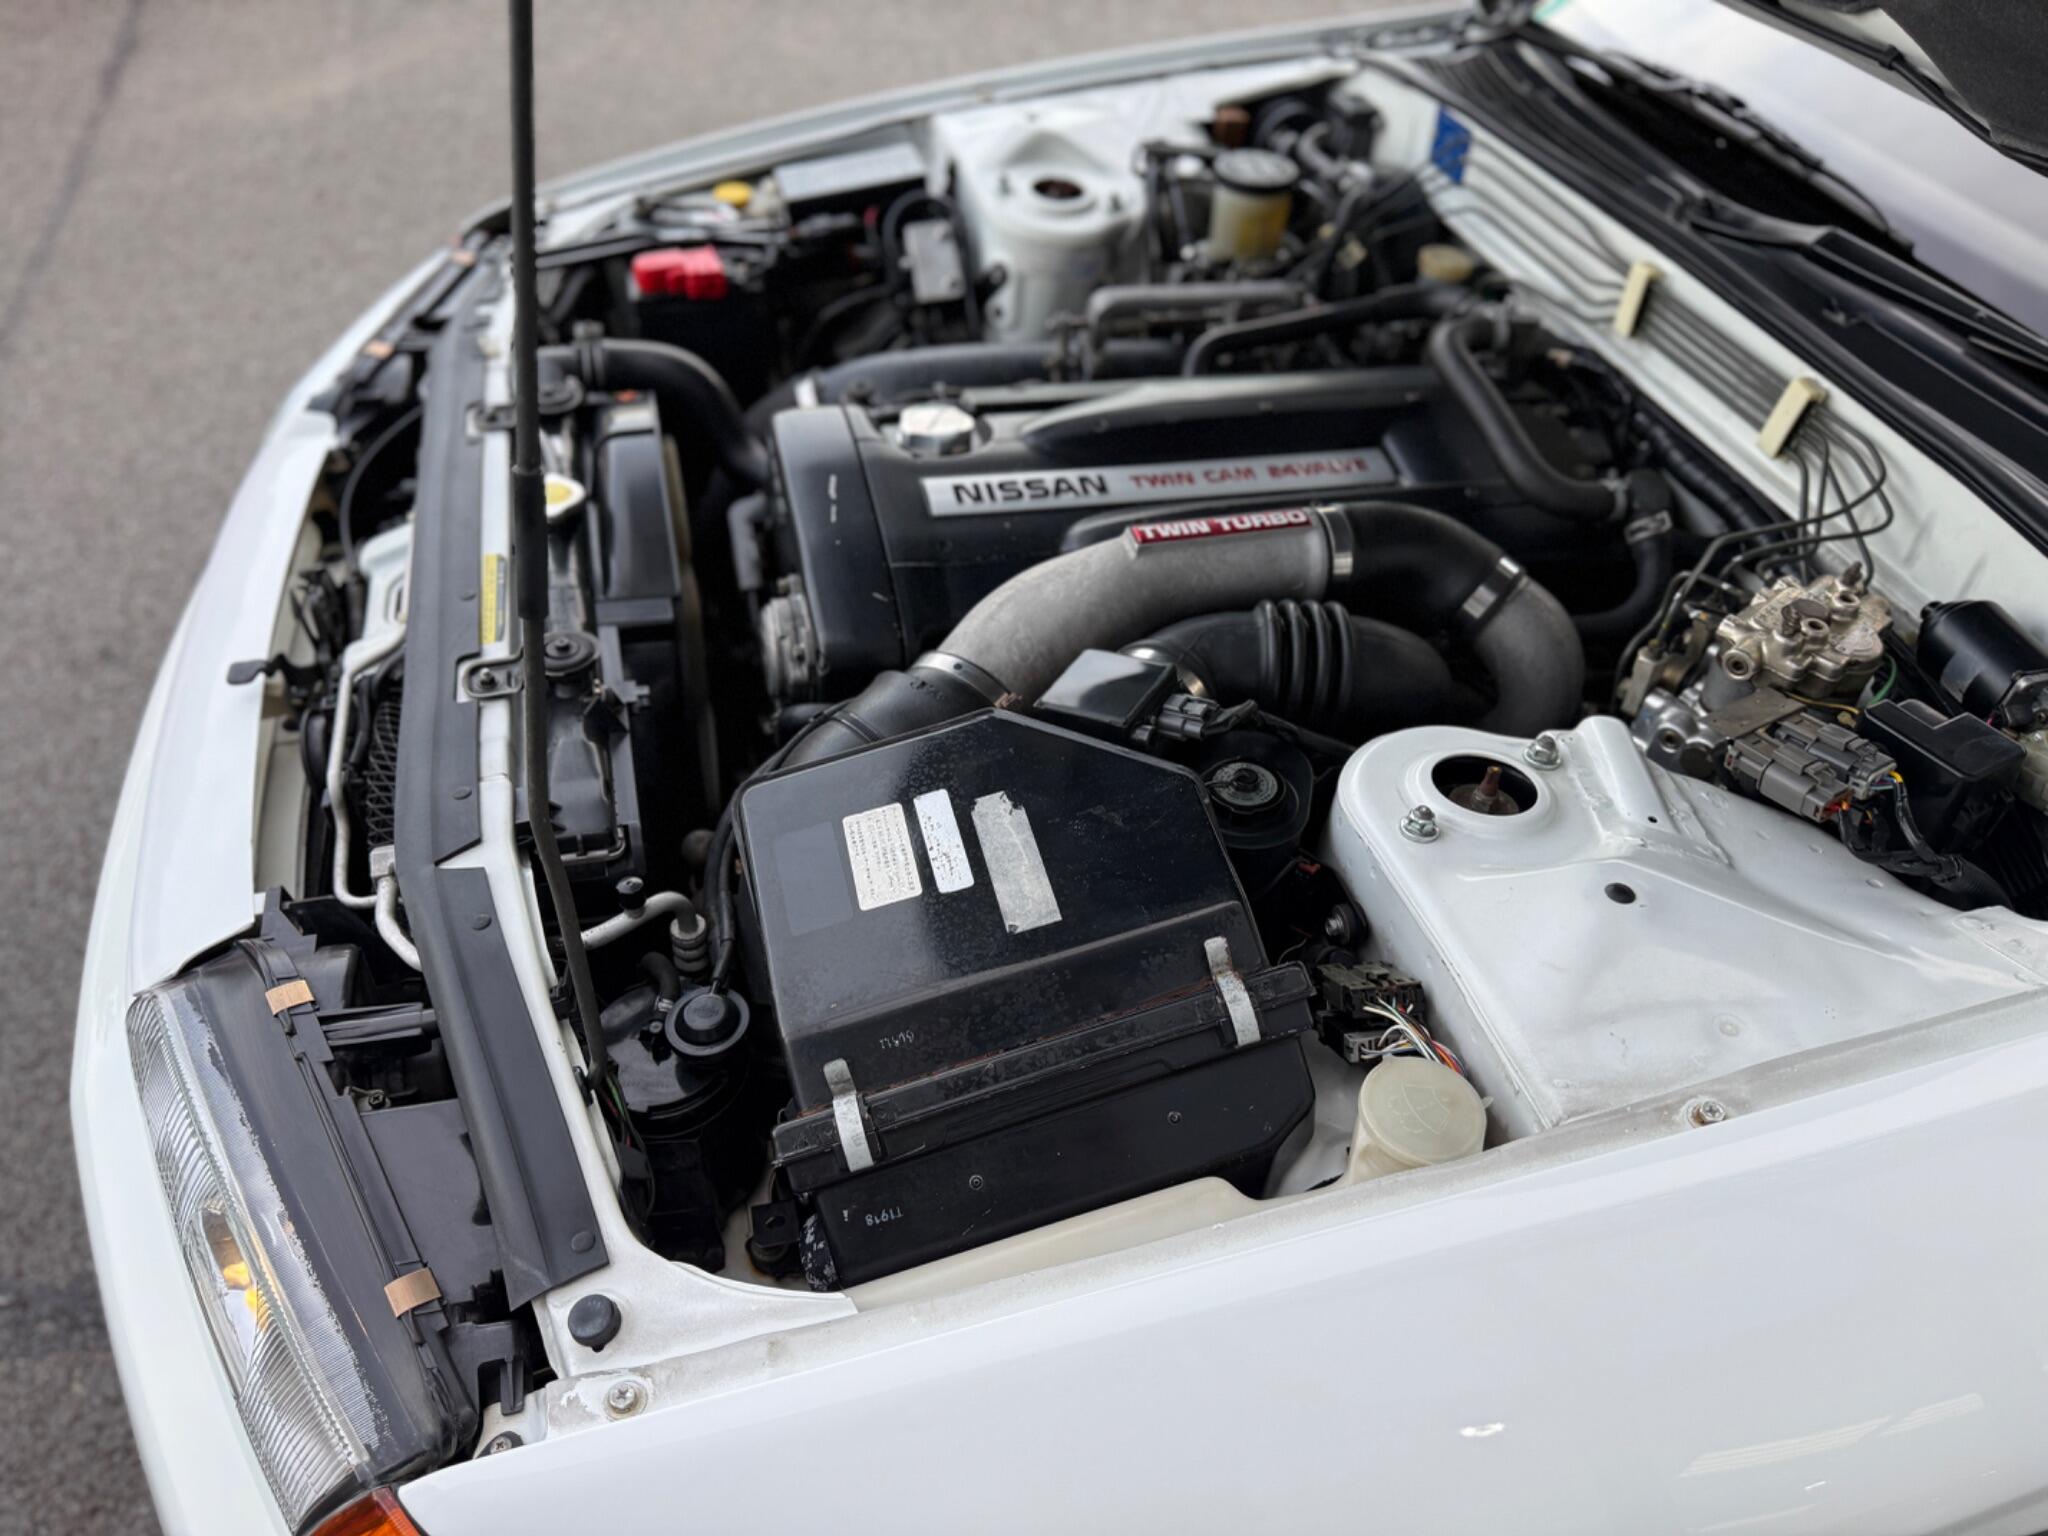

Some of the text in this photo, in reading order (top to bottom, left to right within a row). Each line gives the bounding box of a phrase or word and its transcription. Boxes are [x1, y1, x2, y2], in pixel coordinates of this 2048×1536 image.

[953, 474, 1108, 504] NISSAN
[1129, 467, 1196, 488] TWIN
[1203, 464, 1255, 484] CAM
[1139, 509, 1307, 540] TWIN TURBO
